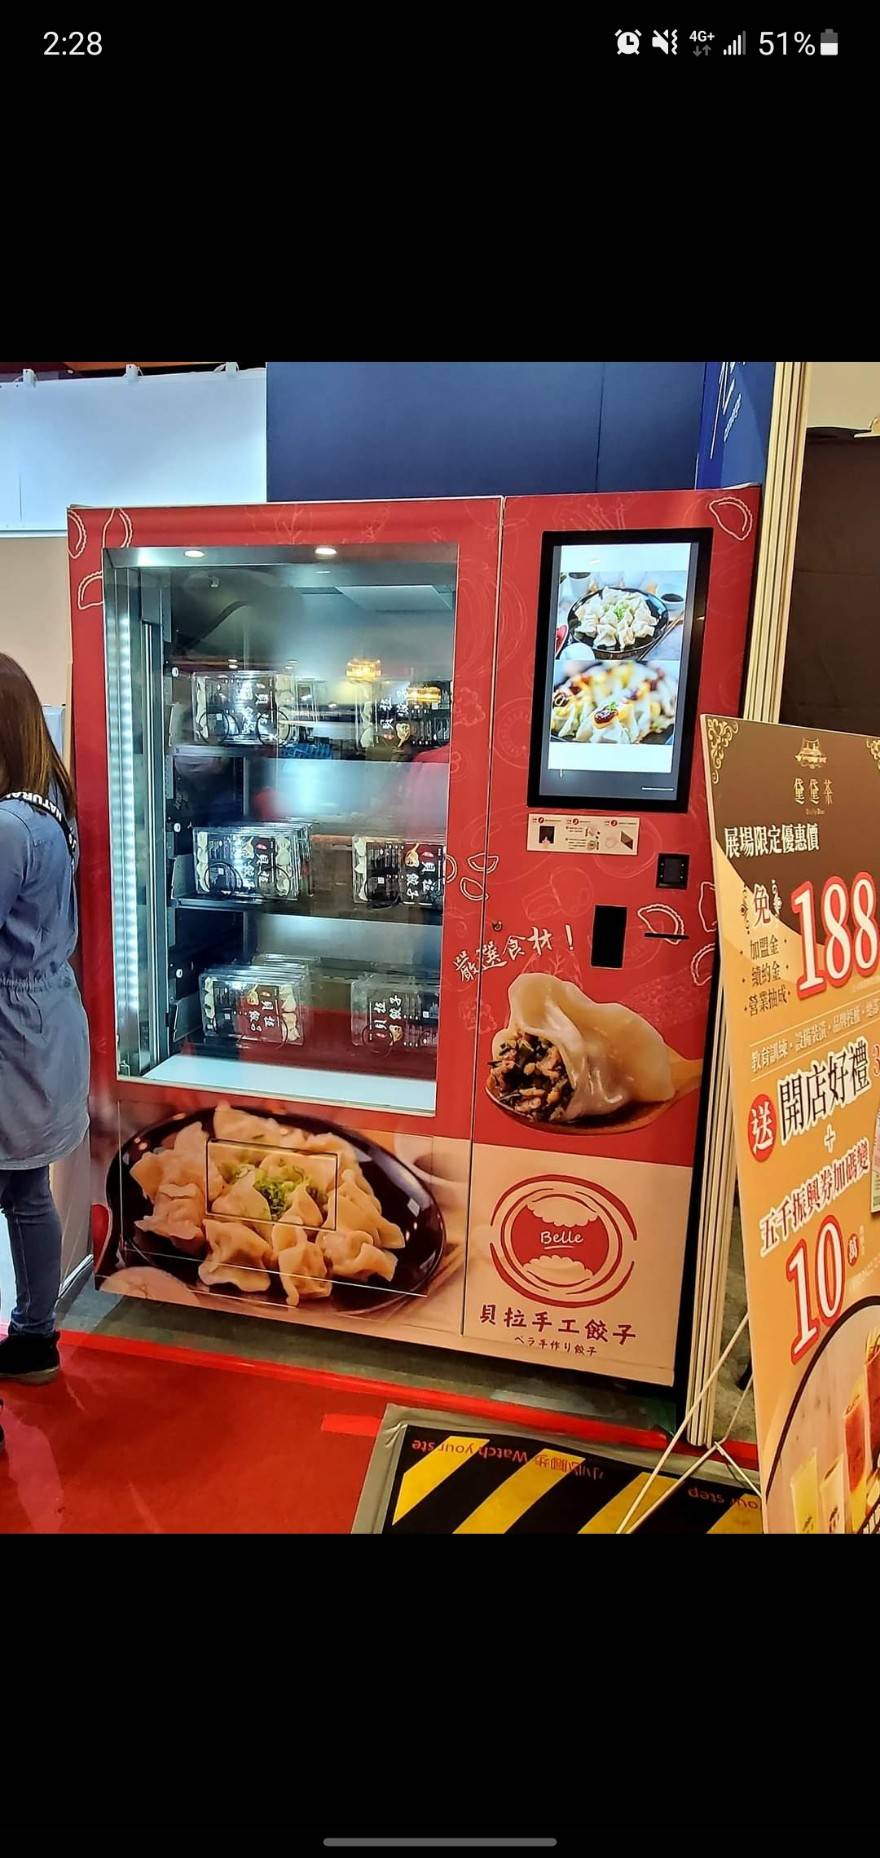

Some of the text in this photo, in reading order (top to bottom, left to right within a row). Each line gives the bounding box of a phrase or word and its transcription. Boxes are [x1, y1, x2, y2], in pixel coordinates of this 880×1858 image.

[724, 823, 819, 858] 展場限定優惠價
[750, 934, 780, 960] 加盟金
[754, 873, 878, 998] 免 188
[751, 1101, 774, 1154] 送
[778, 1038, 871, 1143] 開店好禮
[540, 1231, 584, 1245] Belle
[787, 1217, 844, 1361] 10
[480, 1304, 636, 1345] 貝拉手工餃子
[514, 1336, 598, 1357] ベラ手作り餃子
[438, 1442, 474, 1454] your
[478, 1446, 528, 1463] Watch
[688, 1487, 725, 1504] step
